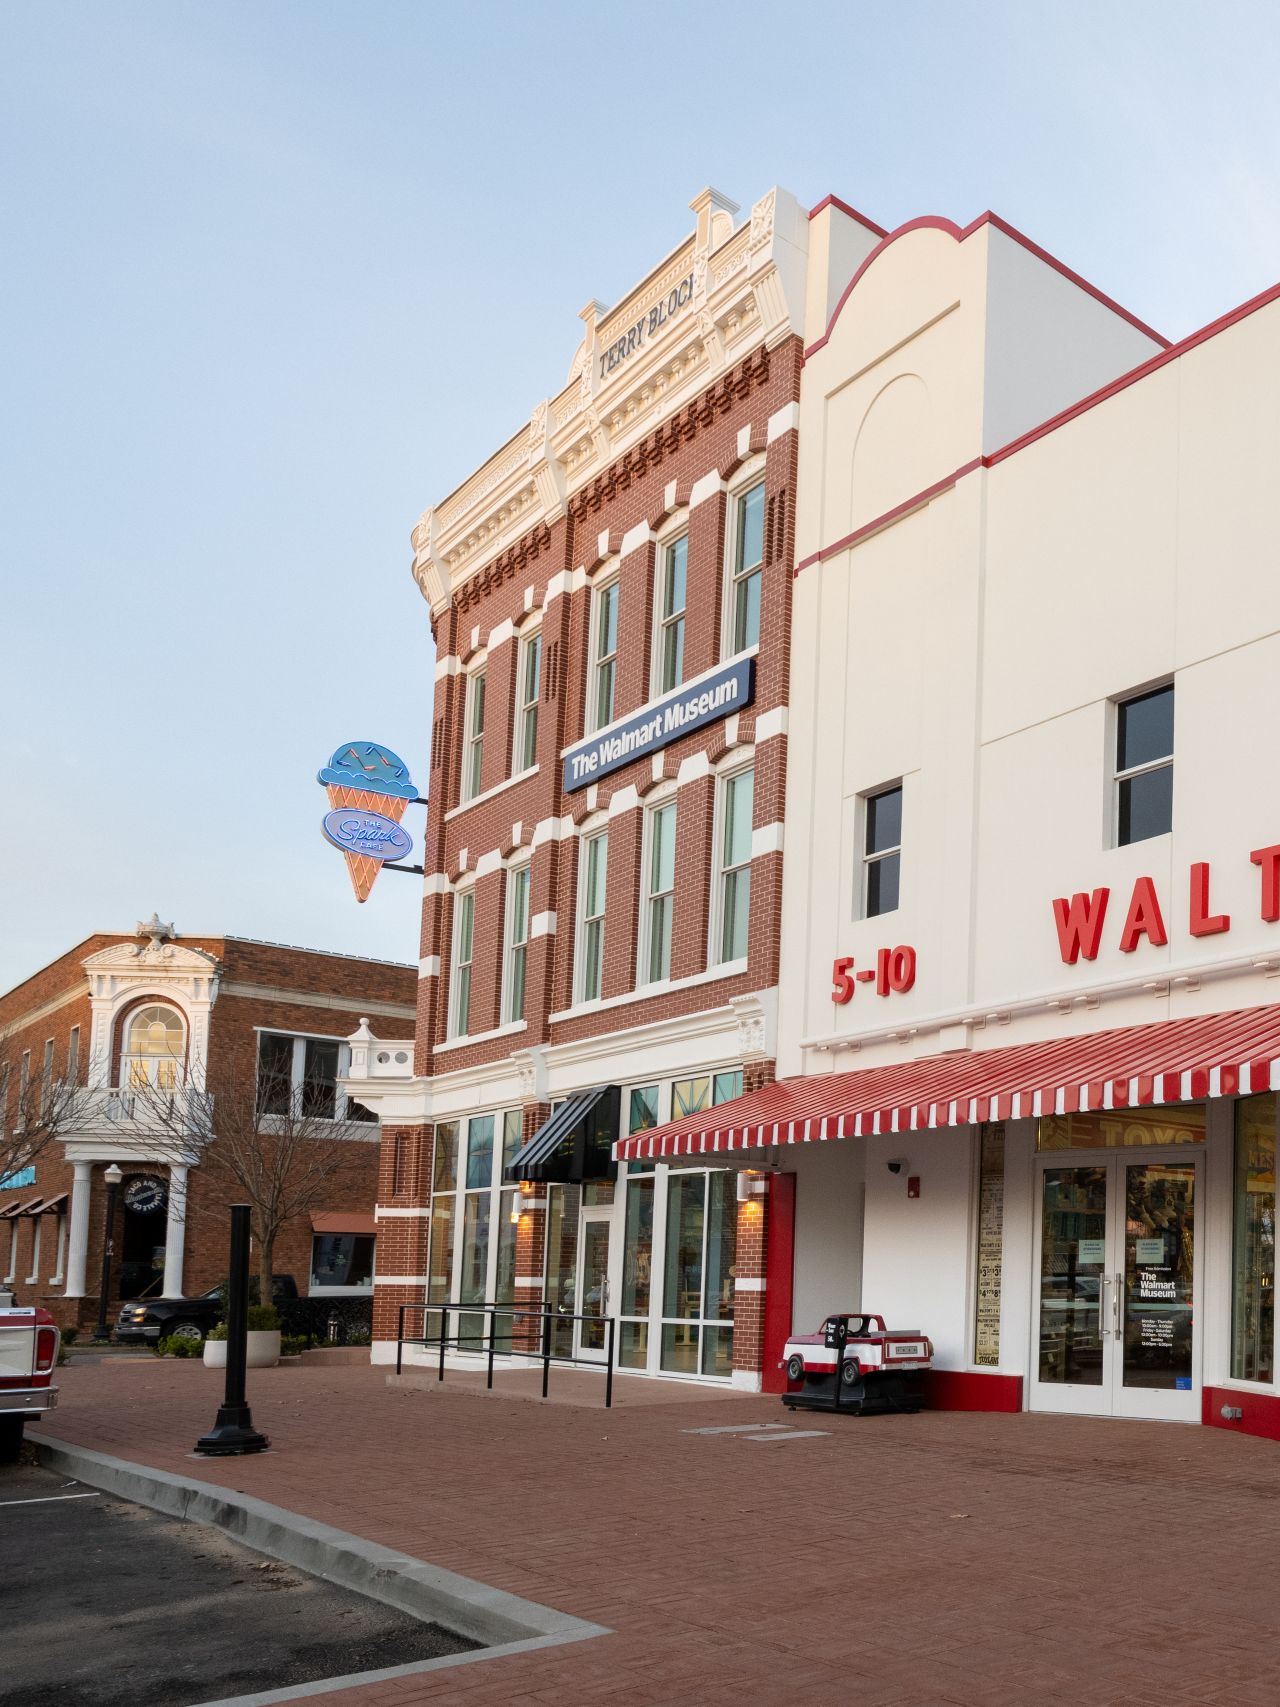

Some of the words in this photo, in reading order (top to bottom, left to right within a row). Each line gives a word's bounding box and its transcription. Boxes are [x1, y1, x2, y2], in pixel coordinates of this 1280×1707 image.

[600, 316, 646, 378] TERRY
[571, 753, 599, 780] The
[599, 714, 662, 766] Walmart
[664, 677, 738, 734] Museum
[337, 818, 404, 846] Spark
[364, 819, 381, 829] THE
[831, 945, 916, 1004] 5-10
[1140, 1281, 1175, 1289] Walmart
[1141, 1272, 1156, 1280] The
[1140, 1289, 1176, 1298] Museum
